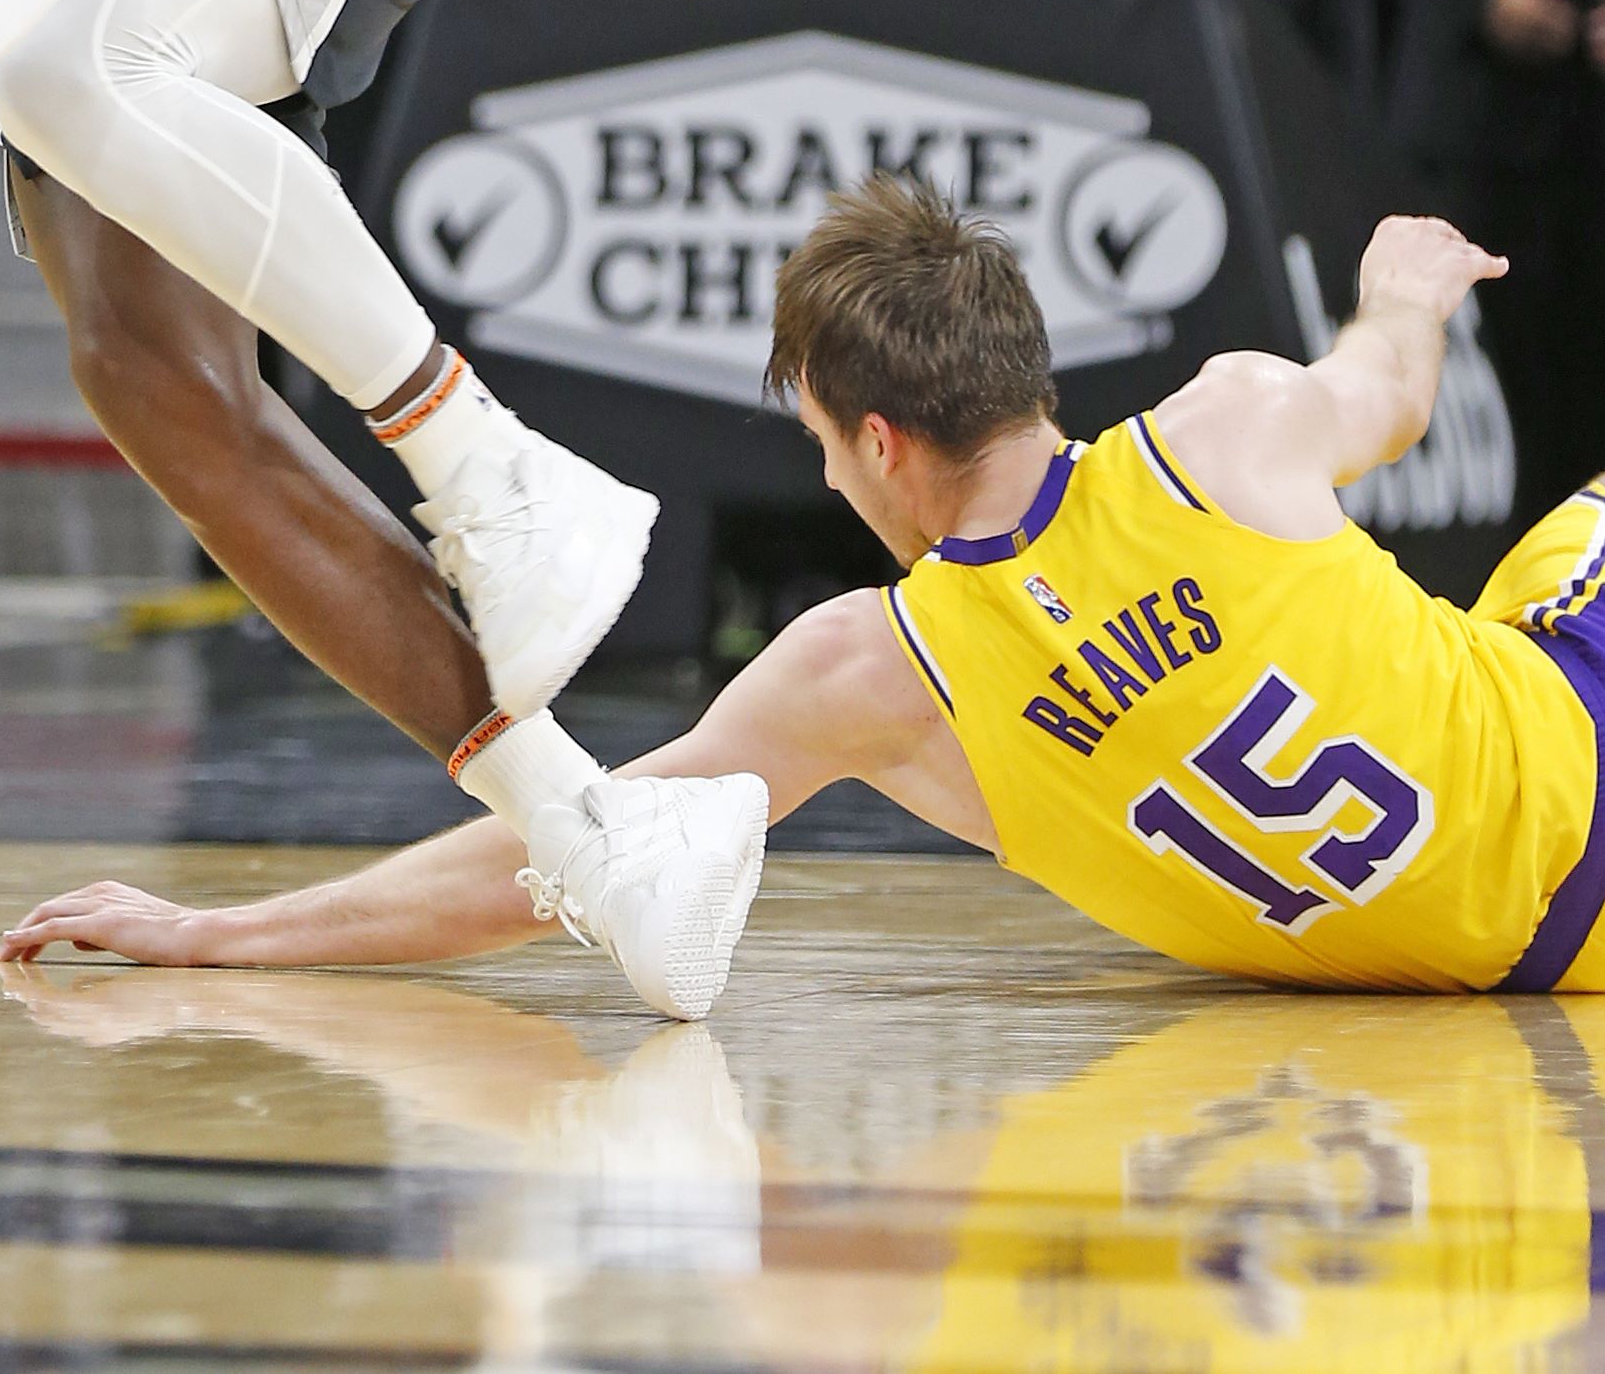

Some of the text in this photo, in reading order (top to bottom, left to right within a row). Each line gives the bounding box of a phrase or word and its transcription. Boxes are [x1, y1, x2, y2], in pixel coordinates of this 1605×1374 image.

[595, 129, 1033, 212] BRAKE
[1021, 577, 1223, 758] REAVES
[1127, 663, 1435, 937] 15
